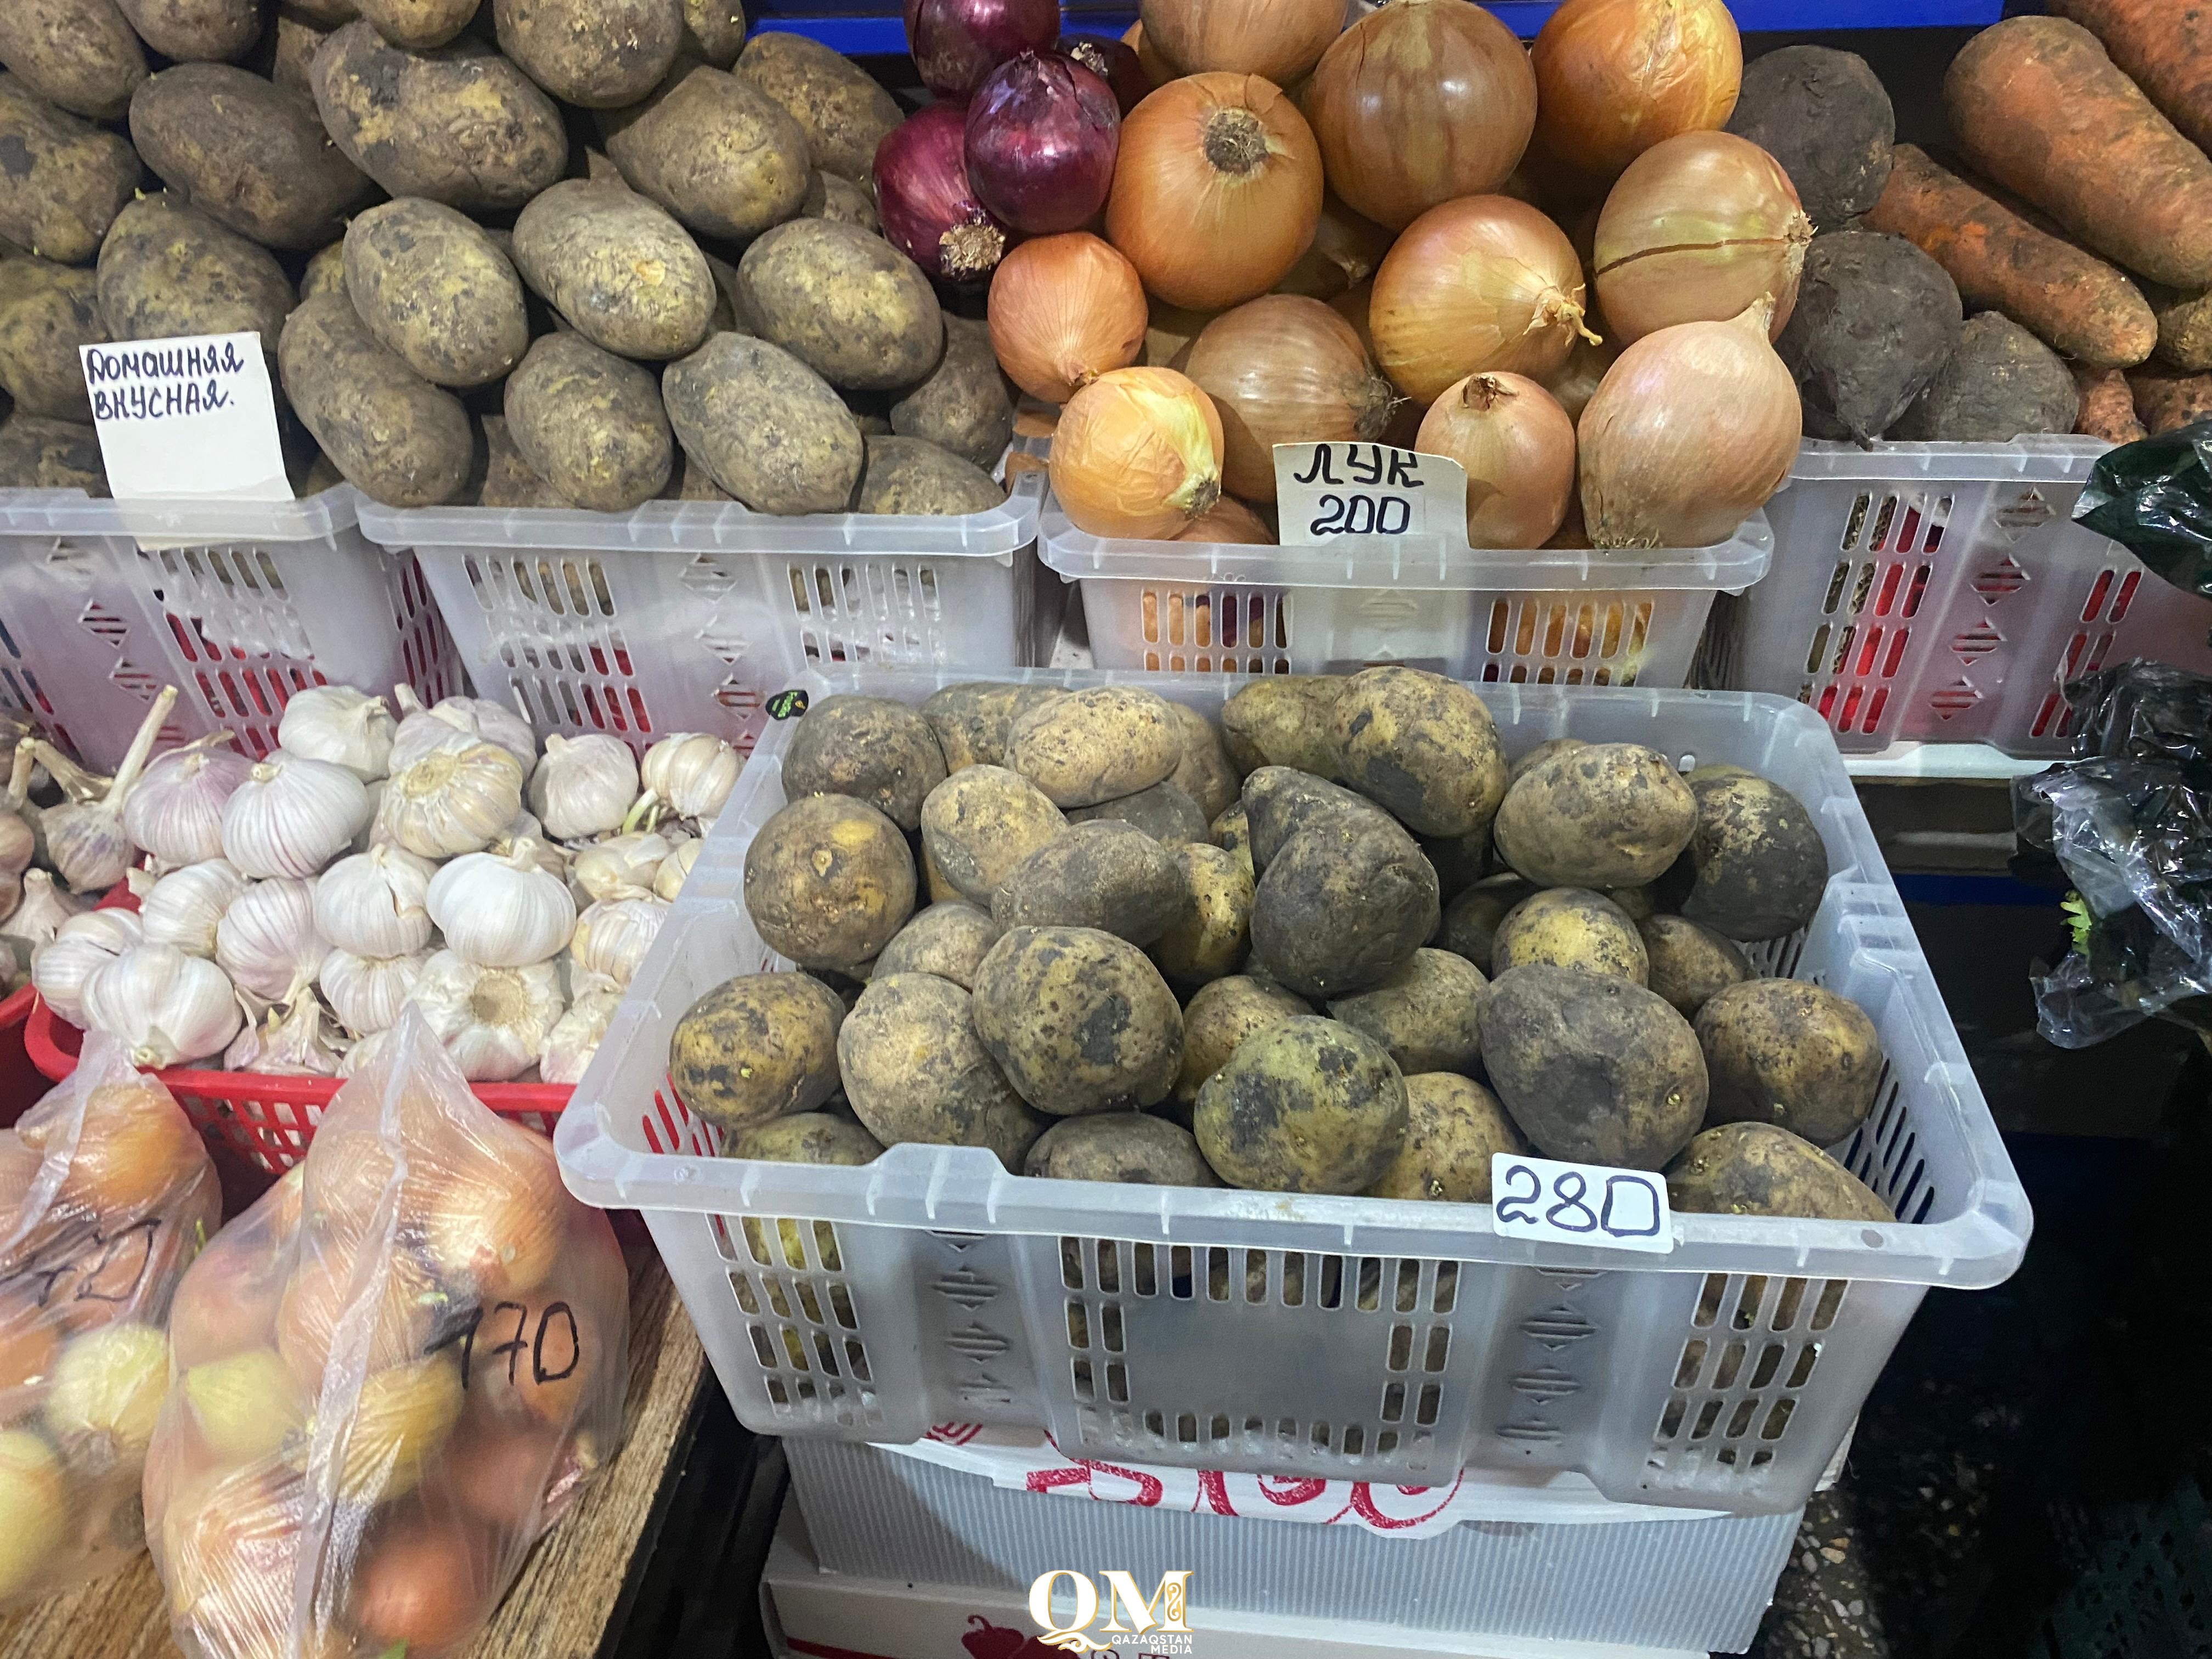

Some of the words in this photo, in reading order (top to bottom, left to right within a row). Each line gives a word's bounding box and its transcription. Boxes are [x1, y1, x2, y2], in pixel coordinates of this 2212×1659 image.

[1293, 443, 1425, 488] ЛУК
[1310, 494, 1410, 535] 200
[1496, 1164, 1661, 1238] 280
[424, 1301, 580, 1390] 170
